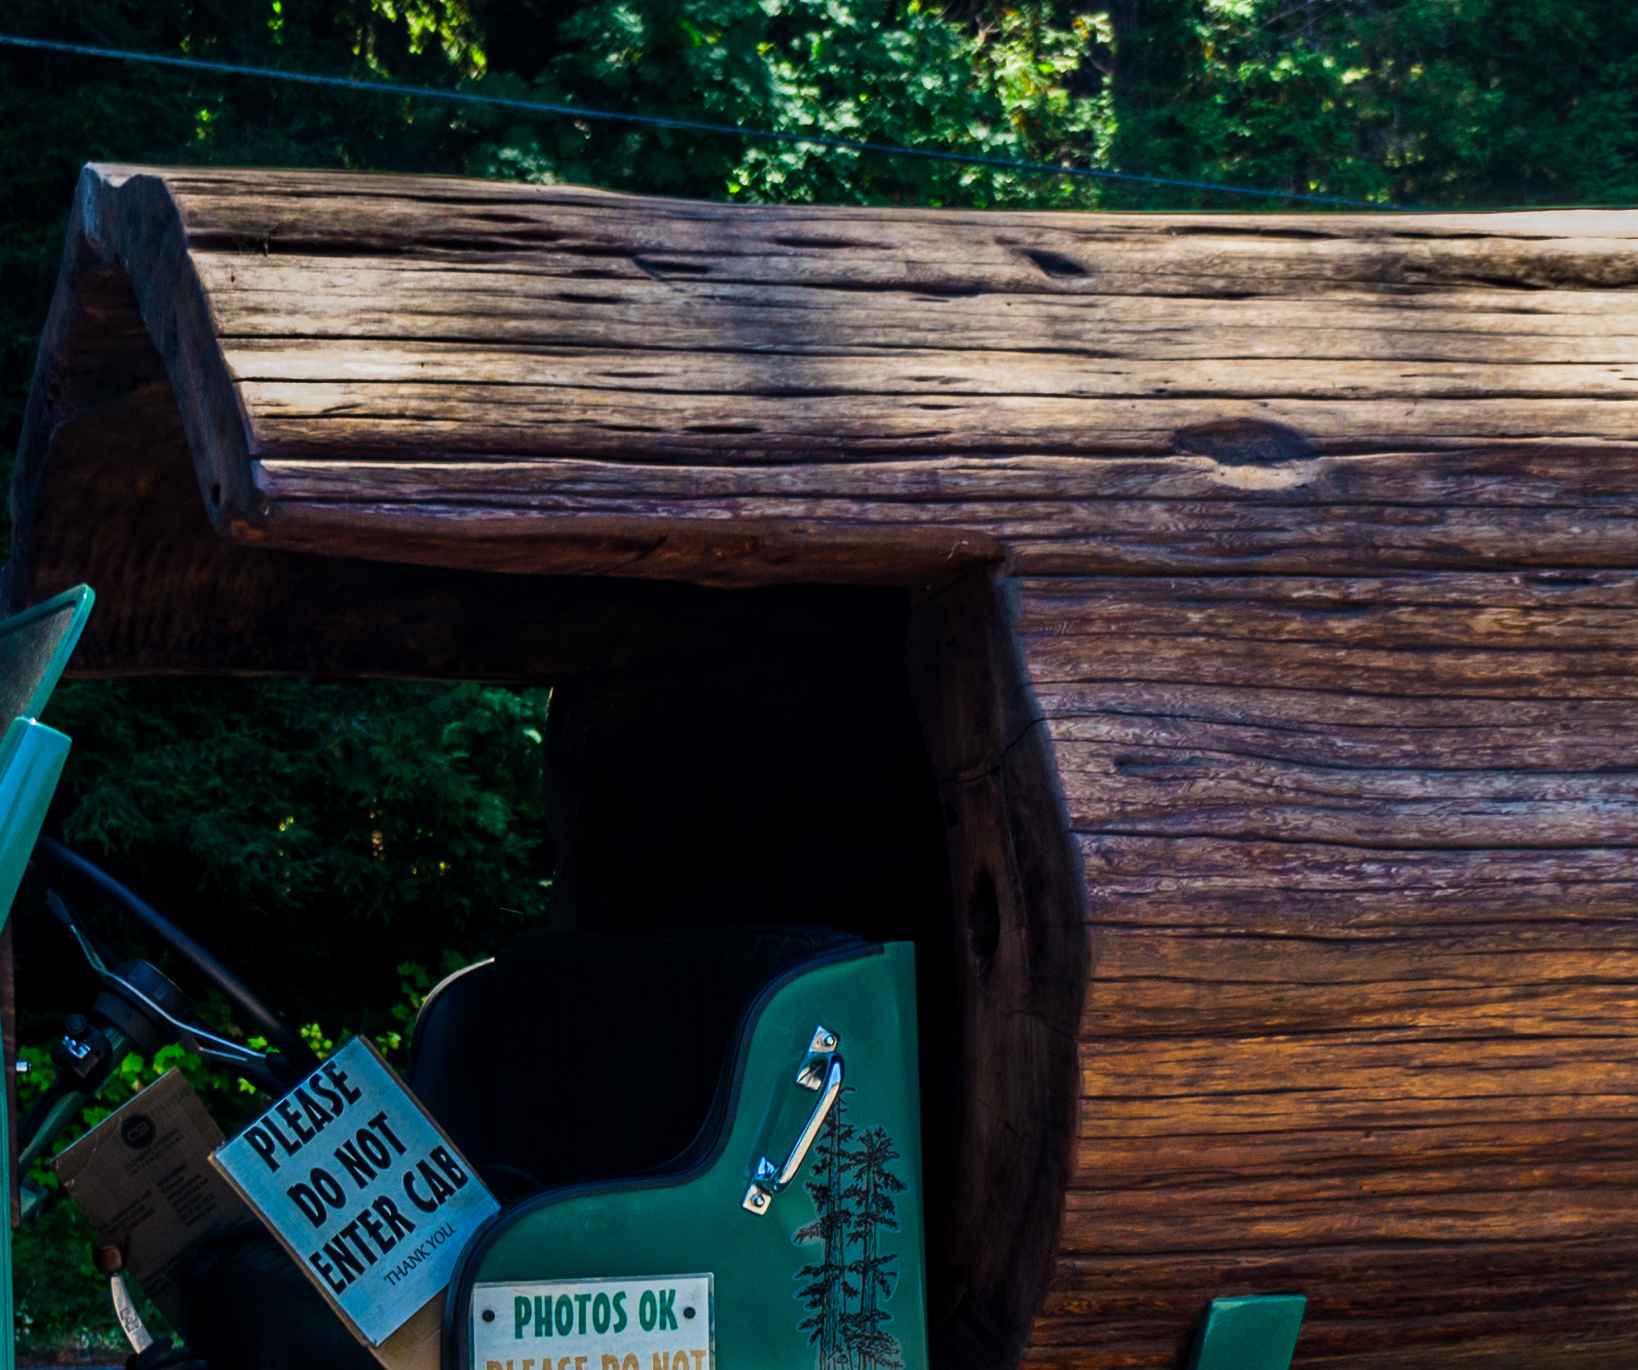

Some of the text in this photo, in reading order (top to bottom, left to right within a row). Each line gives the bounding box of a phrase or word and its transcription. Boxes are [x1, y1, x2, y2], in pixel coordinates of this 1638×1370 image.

[242, 1060, 362, 1172] PLEASE
[286, 1167, 347, 1229] DO
[333, 1111, 407, 1189] NOT
[309, 1195, 416, 1295] ENTER
[402, 1145, 469, 1214] CAB
[383, 1222, 456, 1286] THANK YOU
[514, 1288, 679, 1340] PHOTOS OK
